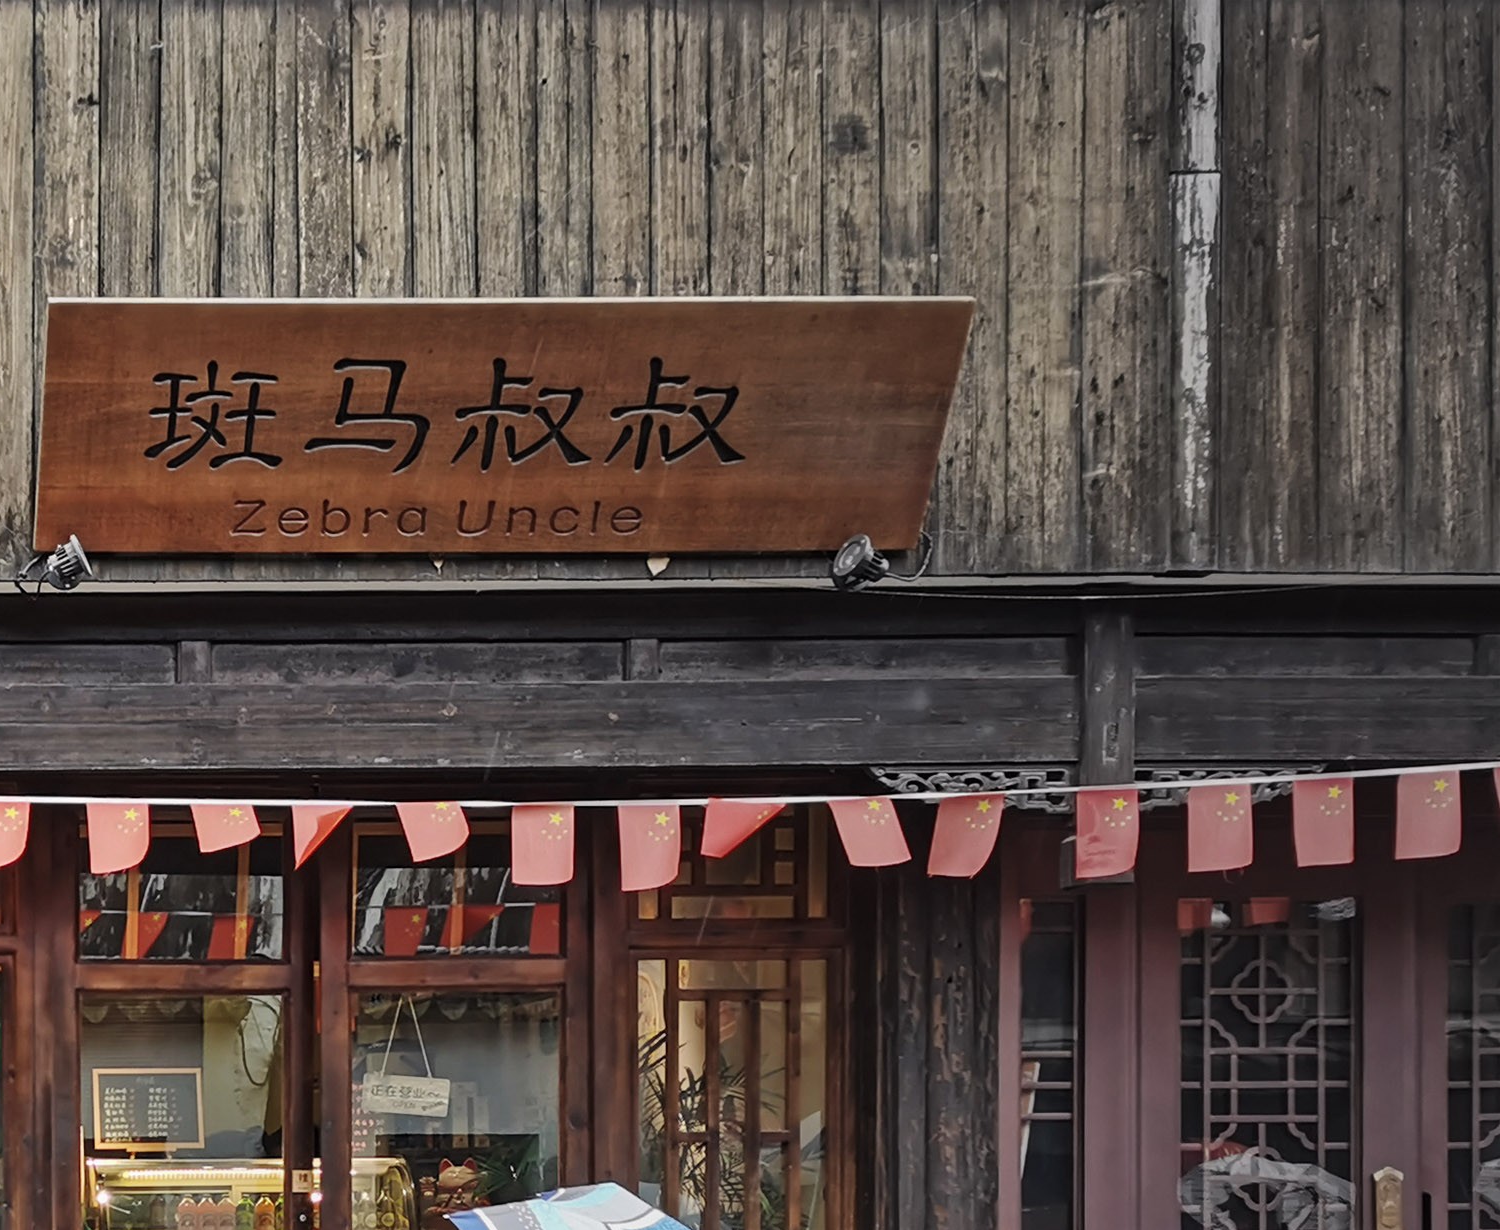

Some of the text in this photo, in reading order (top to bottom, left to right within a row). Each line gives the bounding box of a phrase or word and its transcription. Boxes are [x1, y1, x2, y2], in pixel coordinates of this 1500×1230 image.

[143, 355, 747, 474] 斑马叔叔
[230, 498, 644, 536] Zebra Uncle
